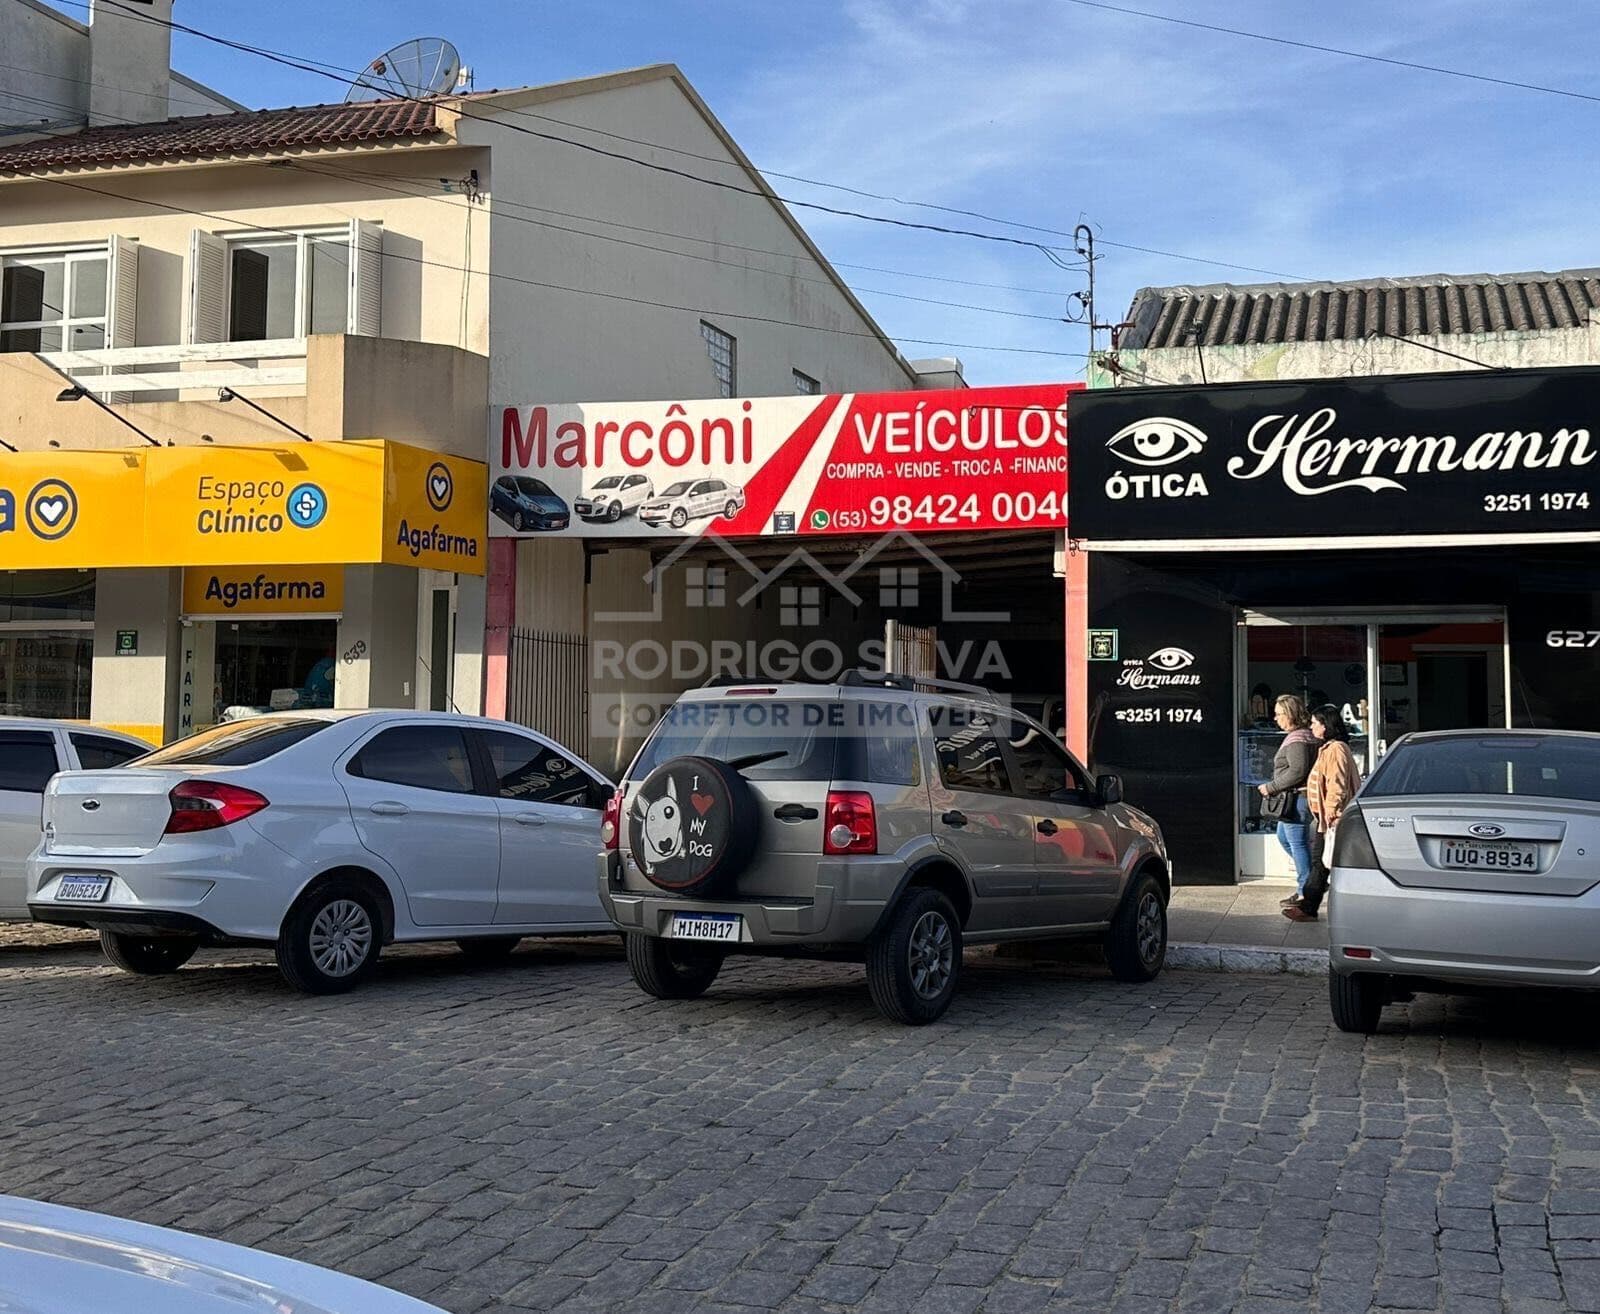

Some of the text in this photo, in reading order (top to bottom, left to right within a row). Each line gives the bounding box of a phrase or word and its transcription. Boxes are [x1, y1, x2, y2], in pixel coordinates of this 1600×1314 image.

[501, 400, 753, 468] Marcôni
[1227, 408, 1597, 495] Herrmann
[827, 462, 884, 479] COMPRA
[895, 461, 941, 478] VENDE
[198, 476, 284, 506] Espaço
[1105, 470, 1209, 500] ÓTICA
[832, 490, 1068, 528] (53) 98424 004
[1484, 493, 1590, 511] 3251 1974
[197, 507, 283, 534] Clínico
[397, 519, 478, 557] Agafarma
[205, 574, 326, 608] Agafarma
[1546, 630, 1600, 648] 627
[343, 640, 367, 665] 639
[1116, 667, 1201, 690] Herrmann
[182, 650, 192, 736] FARM
[1126, 708, 1203, 723] 3251 1974
[692, 776, 699, 791] I
[689, 840, 713, 857] DOG
[678, 920, 733, 939] MIM8H17
